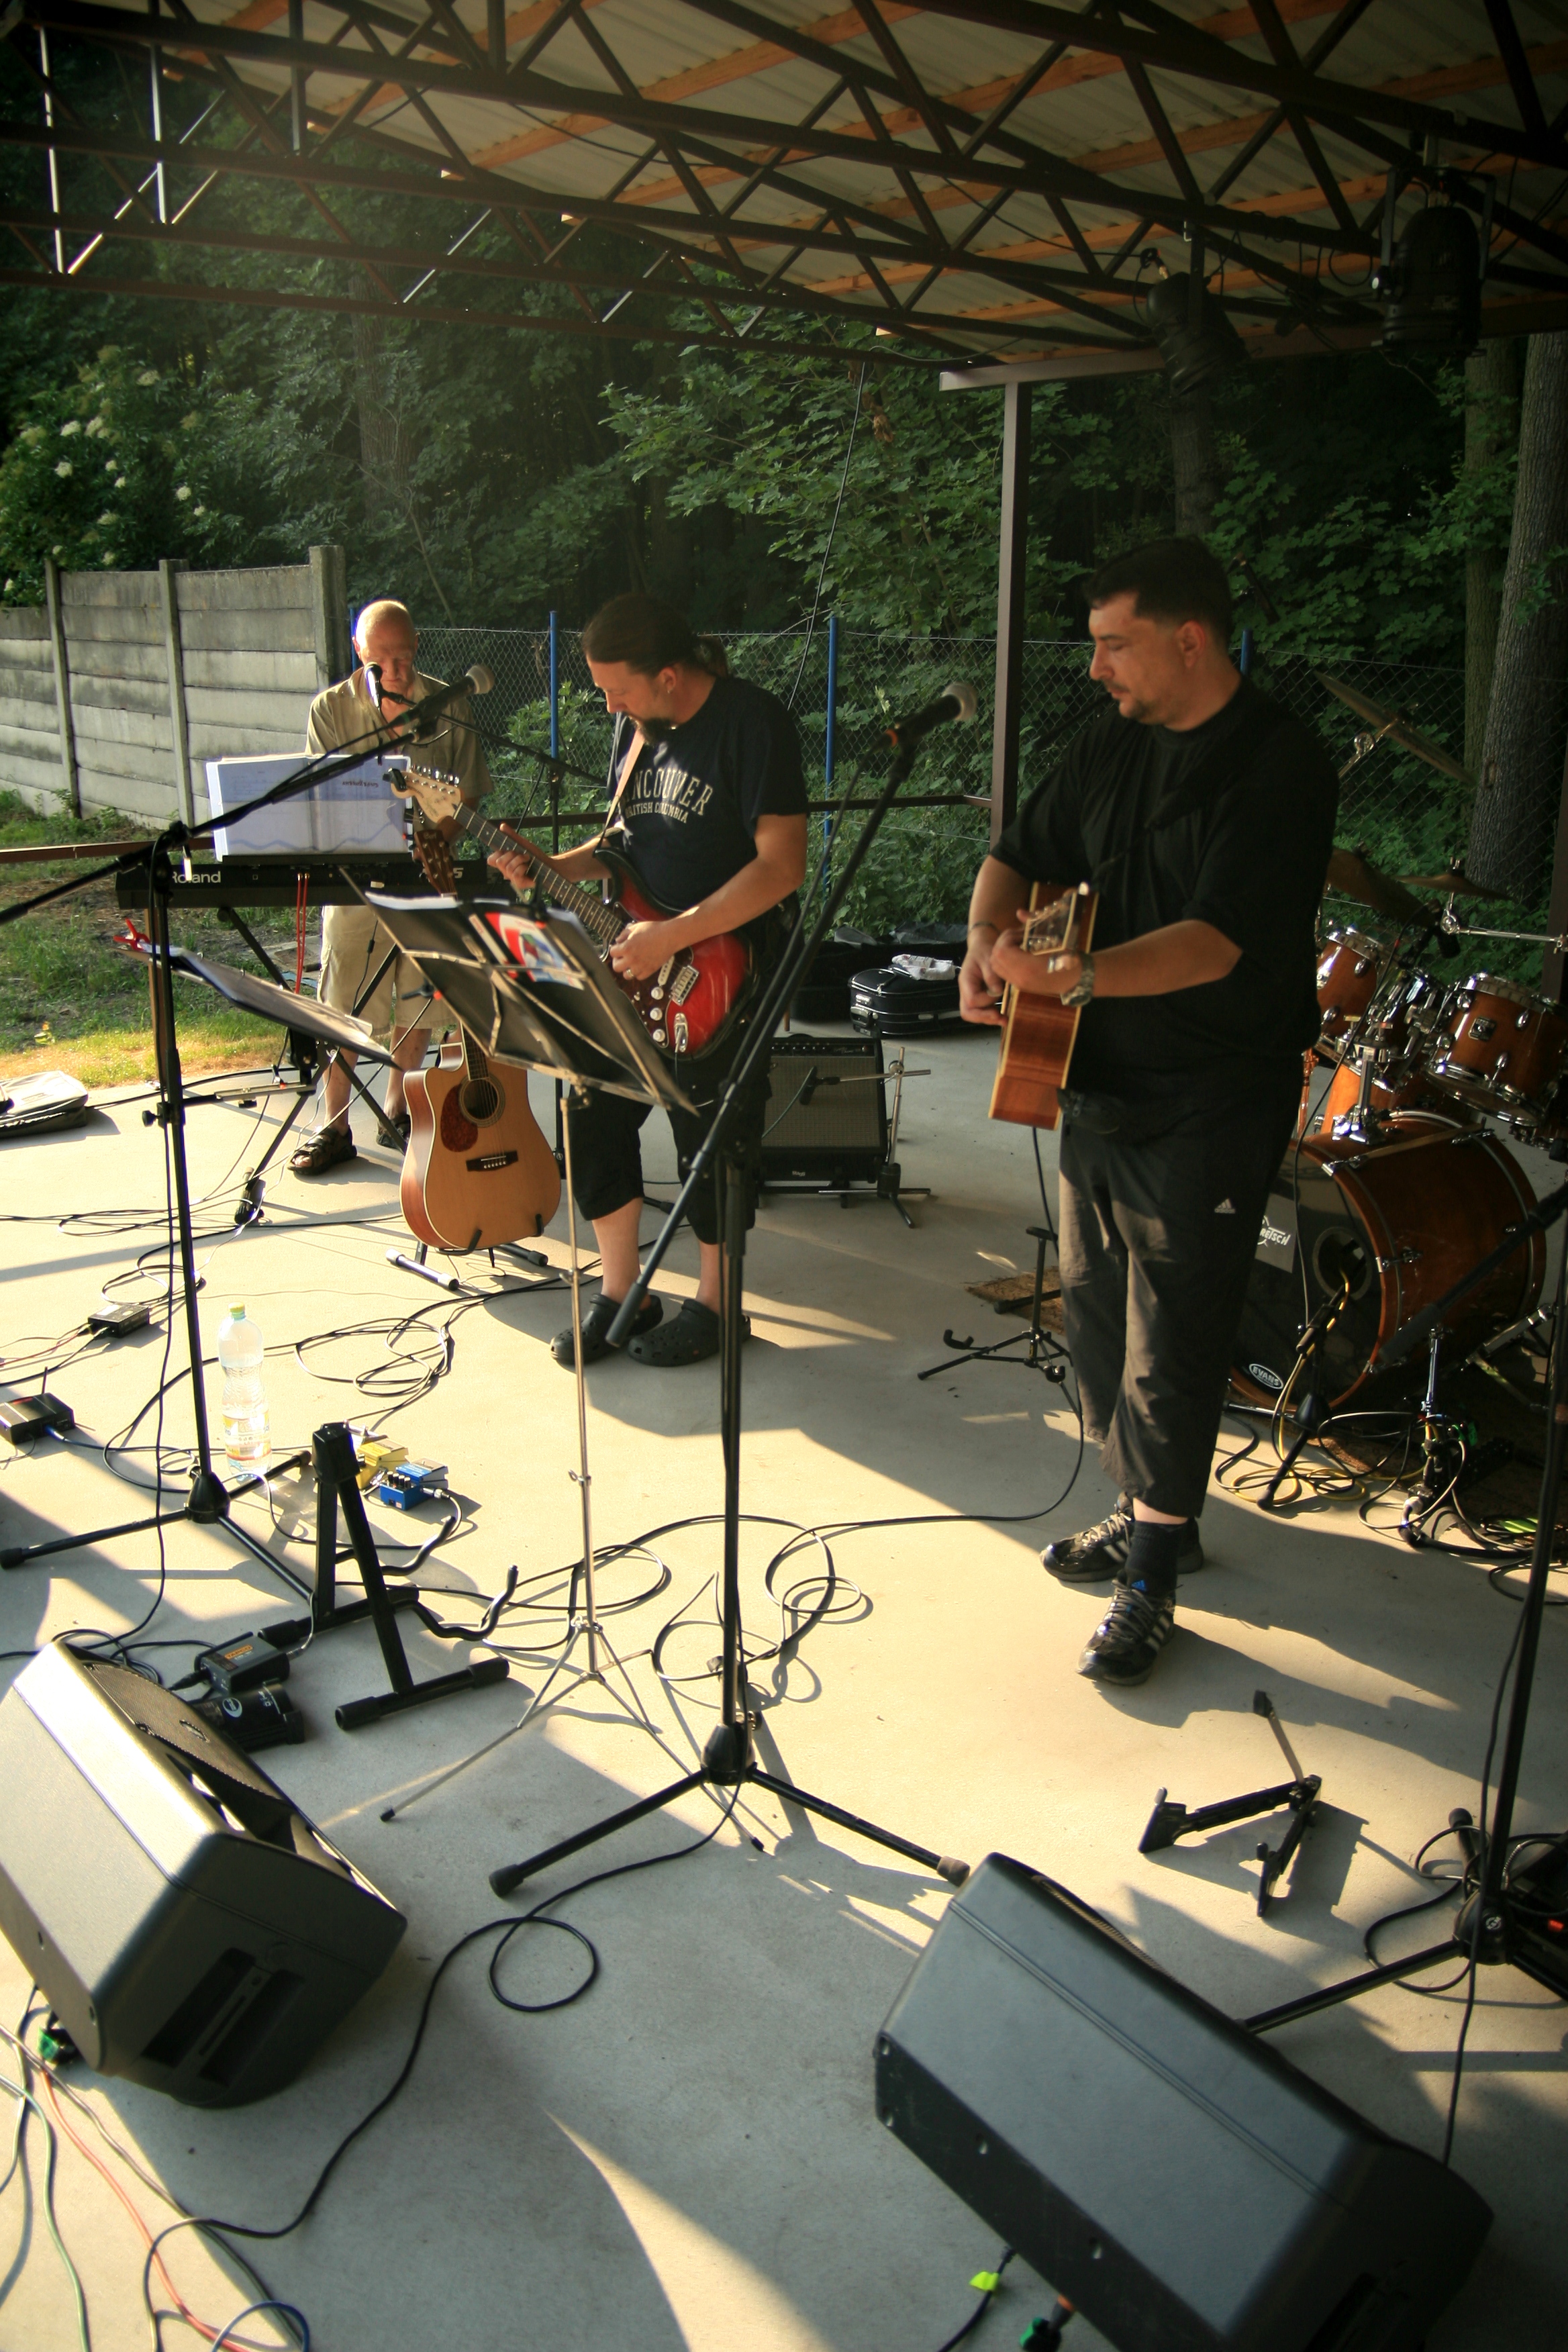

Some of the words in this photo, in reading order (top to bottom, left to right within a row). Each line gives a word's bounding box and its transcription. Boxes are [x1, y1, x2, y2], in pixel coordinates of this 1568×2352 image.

[626, 767, 714, 816] NCOUVER
[172, 871, 222, 883] Roand
[1253, 1366, 1279, 1386] EVANS
